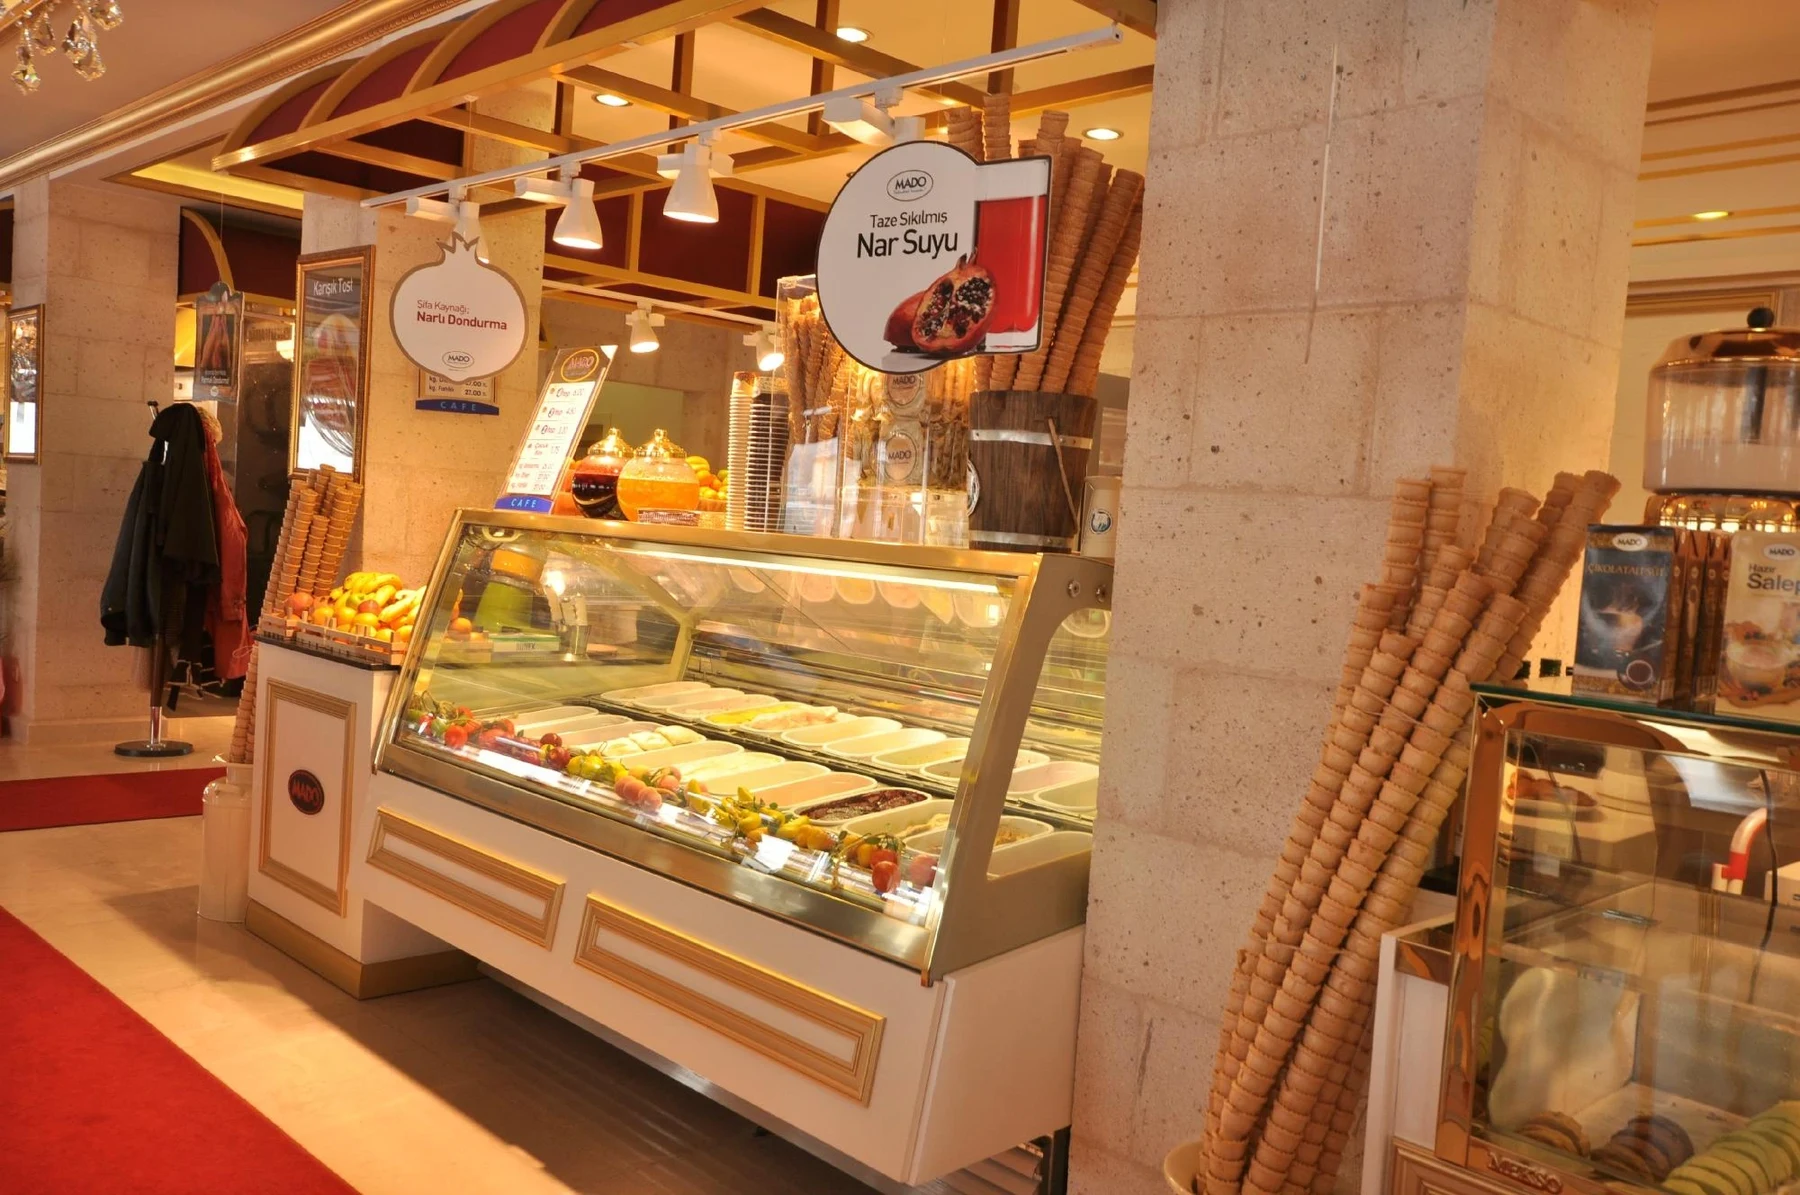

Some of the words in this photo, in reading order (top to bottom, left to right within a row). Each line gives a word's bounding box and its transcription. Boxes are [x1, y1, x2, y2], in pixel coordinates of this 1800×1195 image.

[895, 176, 927, 190] MADO
[870, 214, 898, 229] Taze
[900, 210, 948, 226] Sıkılmış
[857, 232, 899, 258] Nar
[903, 229, 959, 260] Suyu
[313, 279, 337, 296] Karışık
[338, 278, 353, 292] Tost
[417, 311, 446, 325] Narlı
[448, 314, 508, 330] Dondurma
[448, 355, 470, 363] MADO
[893, 375, 916, 384] MADO
[440, 401, 477, 411] CAFE
[888, 450, 912, 460] MADO
[510, 498, 537, 508] CAFE
[1618, 538, 1642, 546] MADO
[1769, 548, 1796, 556] MADO
